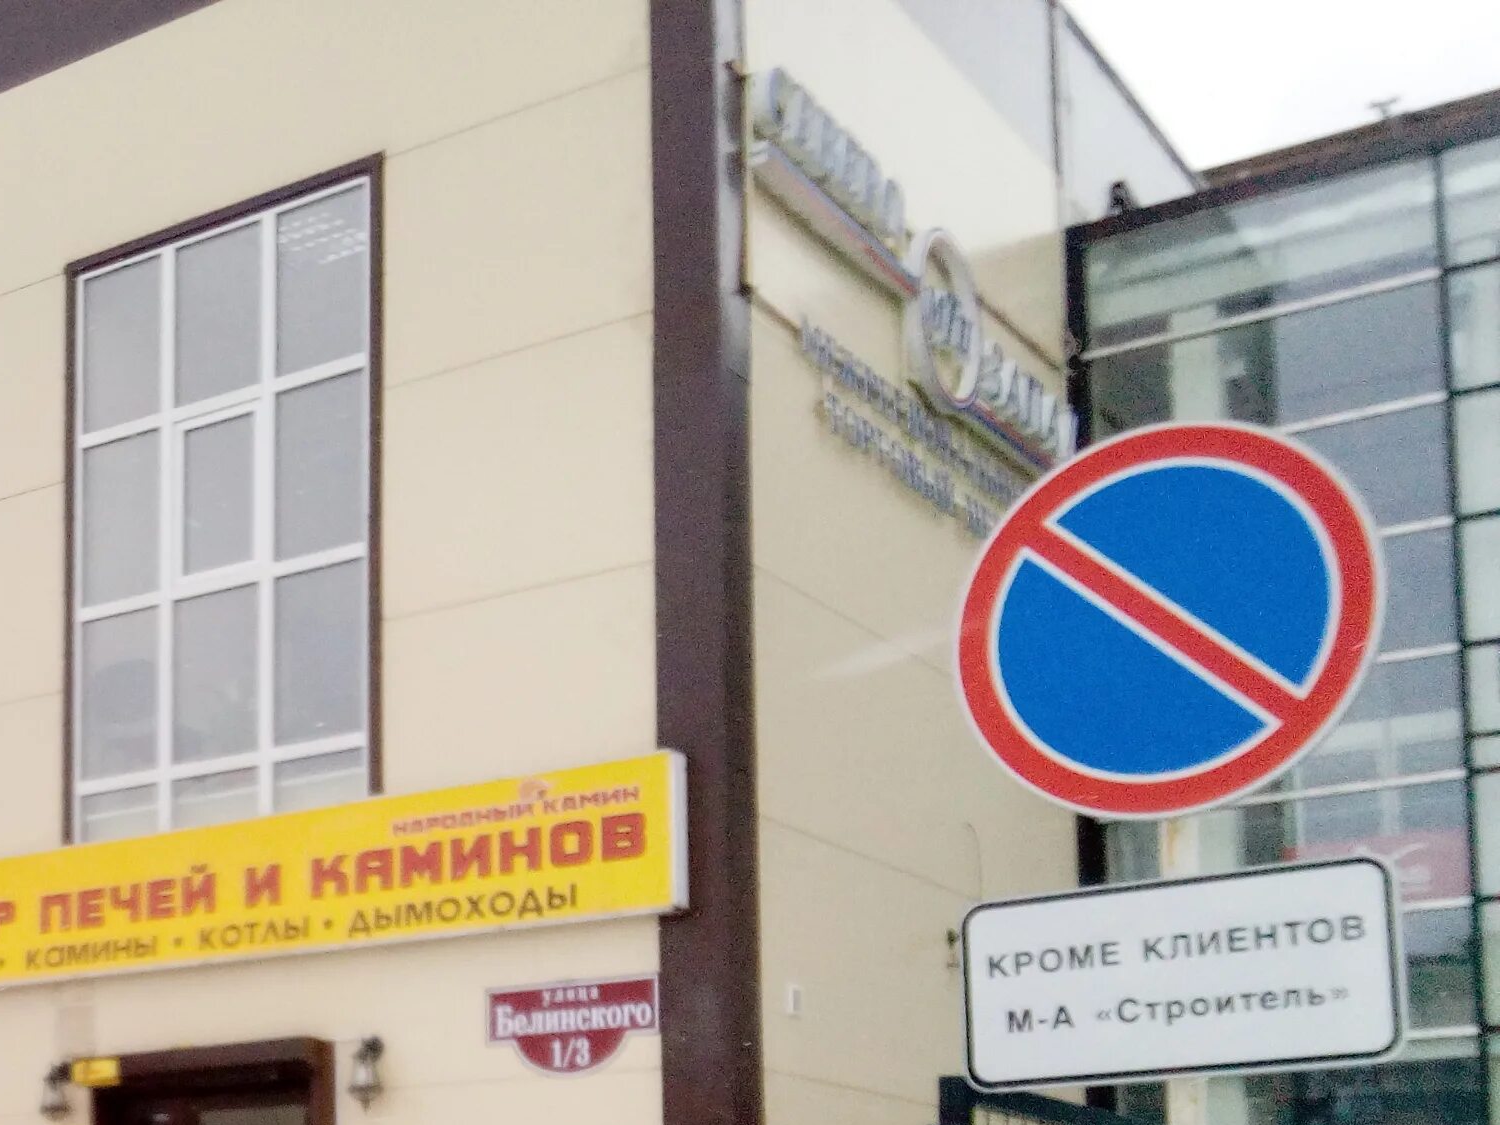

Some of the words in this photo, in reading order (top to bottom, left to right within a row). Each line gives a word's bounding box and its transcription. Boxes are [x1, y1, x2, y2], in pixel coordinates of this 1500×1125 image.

[543, 785, 641, 815] КАМИН
[38, 863, 217, 934] ПЕЧЕЙ
[244, 863, 283, 908] И
[310, 812, 648, 899] КАМИНОВ
[987, 941, 1121, 979] КРОМЕ
[1142, 914, 1366, 962] КЛИЕНТОВ
[494, 1001, 653, 1037] Белинского
[1007, 1004, 1075, 1034] М-А
[551, 1036, 591, 1068] 1/3
